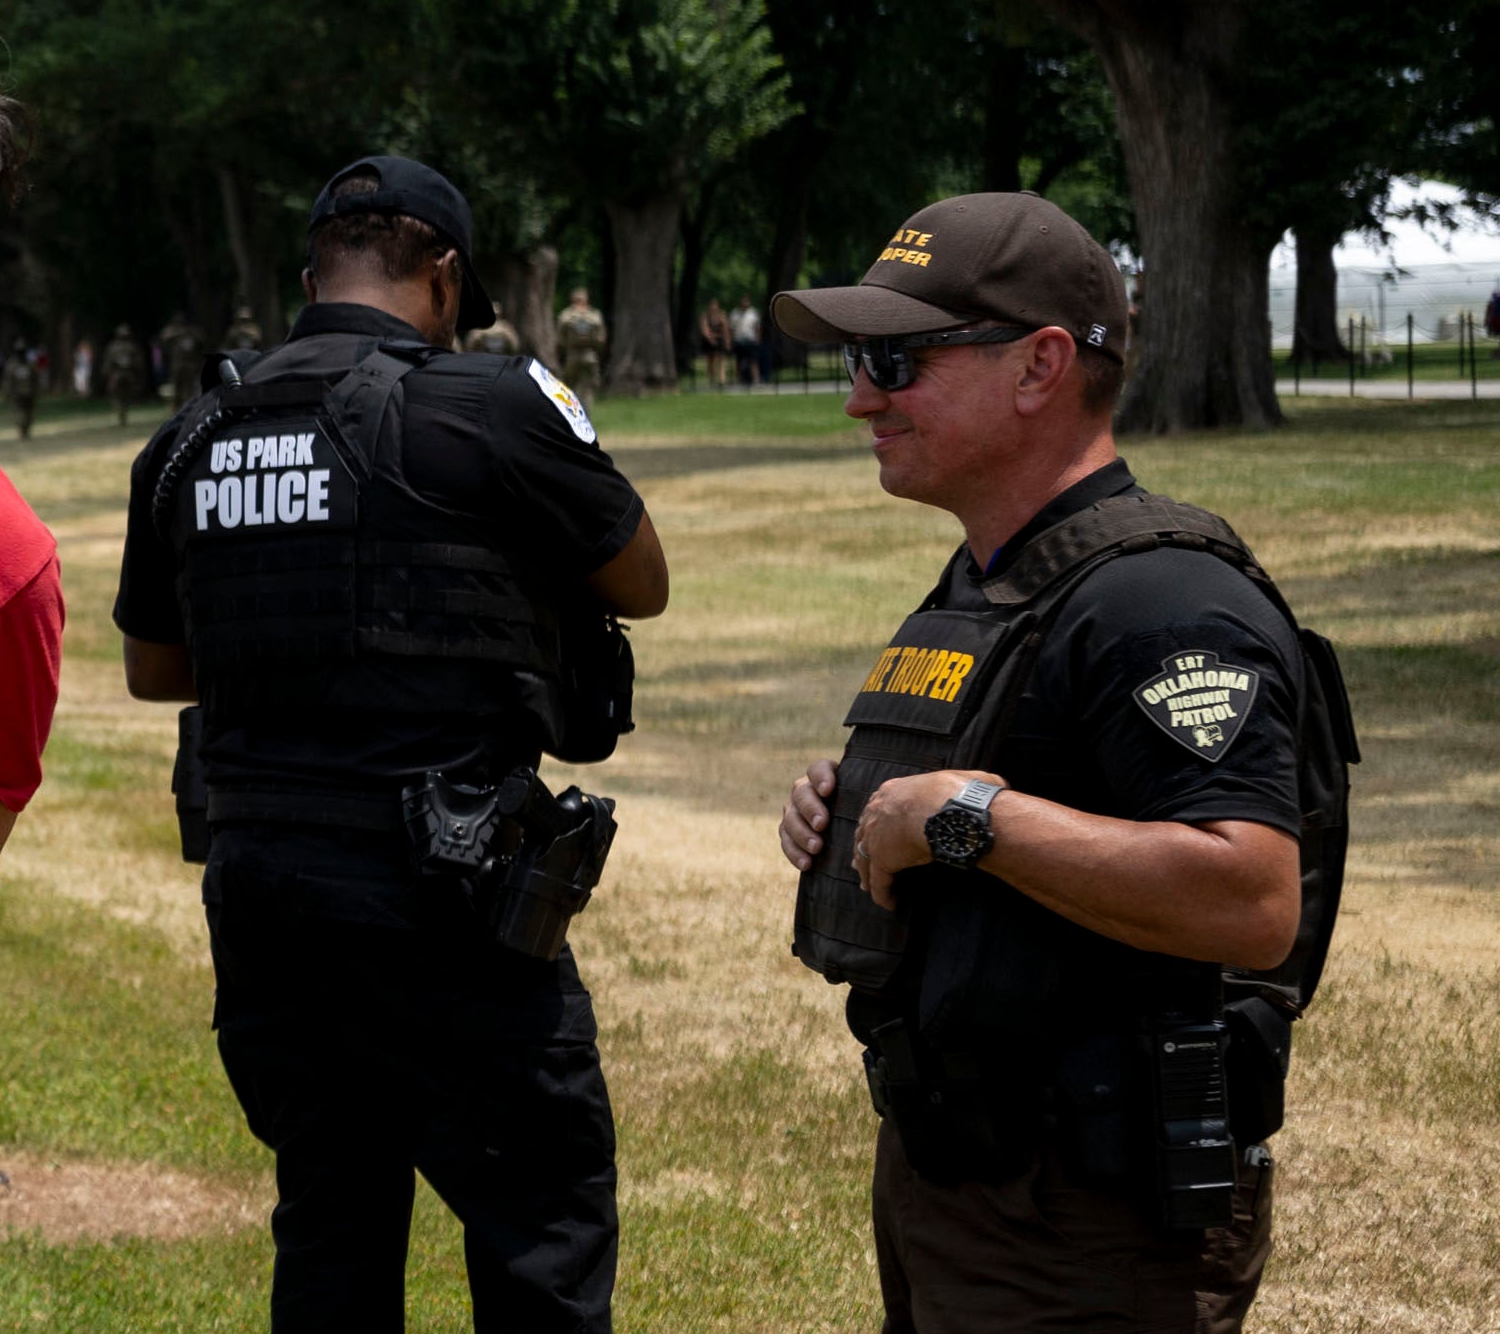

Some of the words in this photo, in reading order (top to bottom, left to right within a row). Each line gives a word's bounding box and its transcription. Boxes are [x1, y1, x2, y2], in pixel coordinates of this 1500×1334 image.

[210, 439, 243, 473] US
[246, 433, 315, 470] PARK
[195, 469, 330, 531] POLICE
[885, 647, 974, 702] TROOPER
[1175, 656, 1204, 671] ERT
[1142, 671, 1249, 704] OKLAHOMA
[1167, 690, 1230, 711] HIGHWAY
[1171, 703, 1238, 727] PATROL
